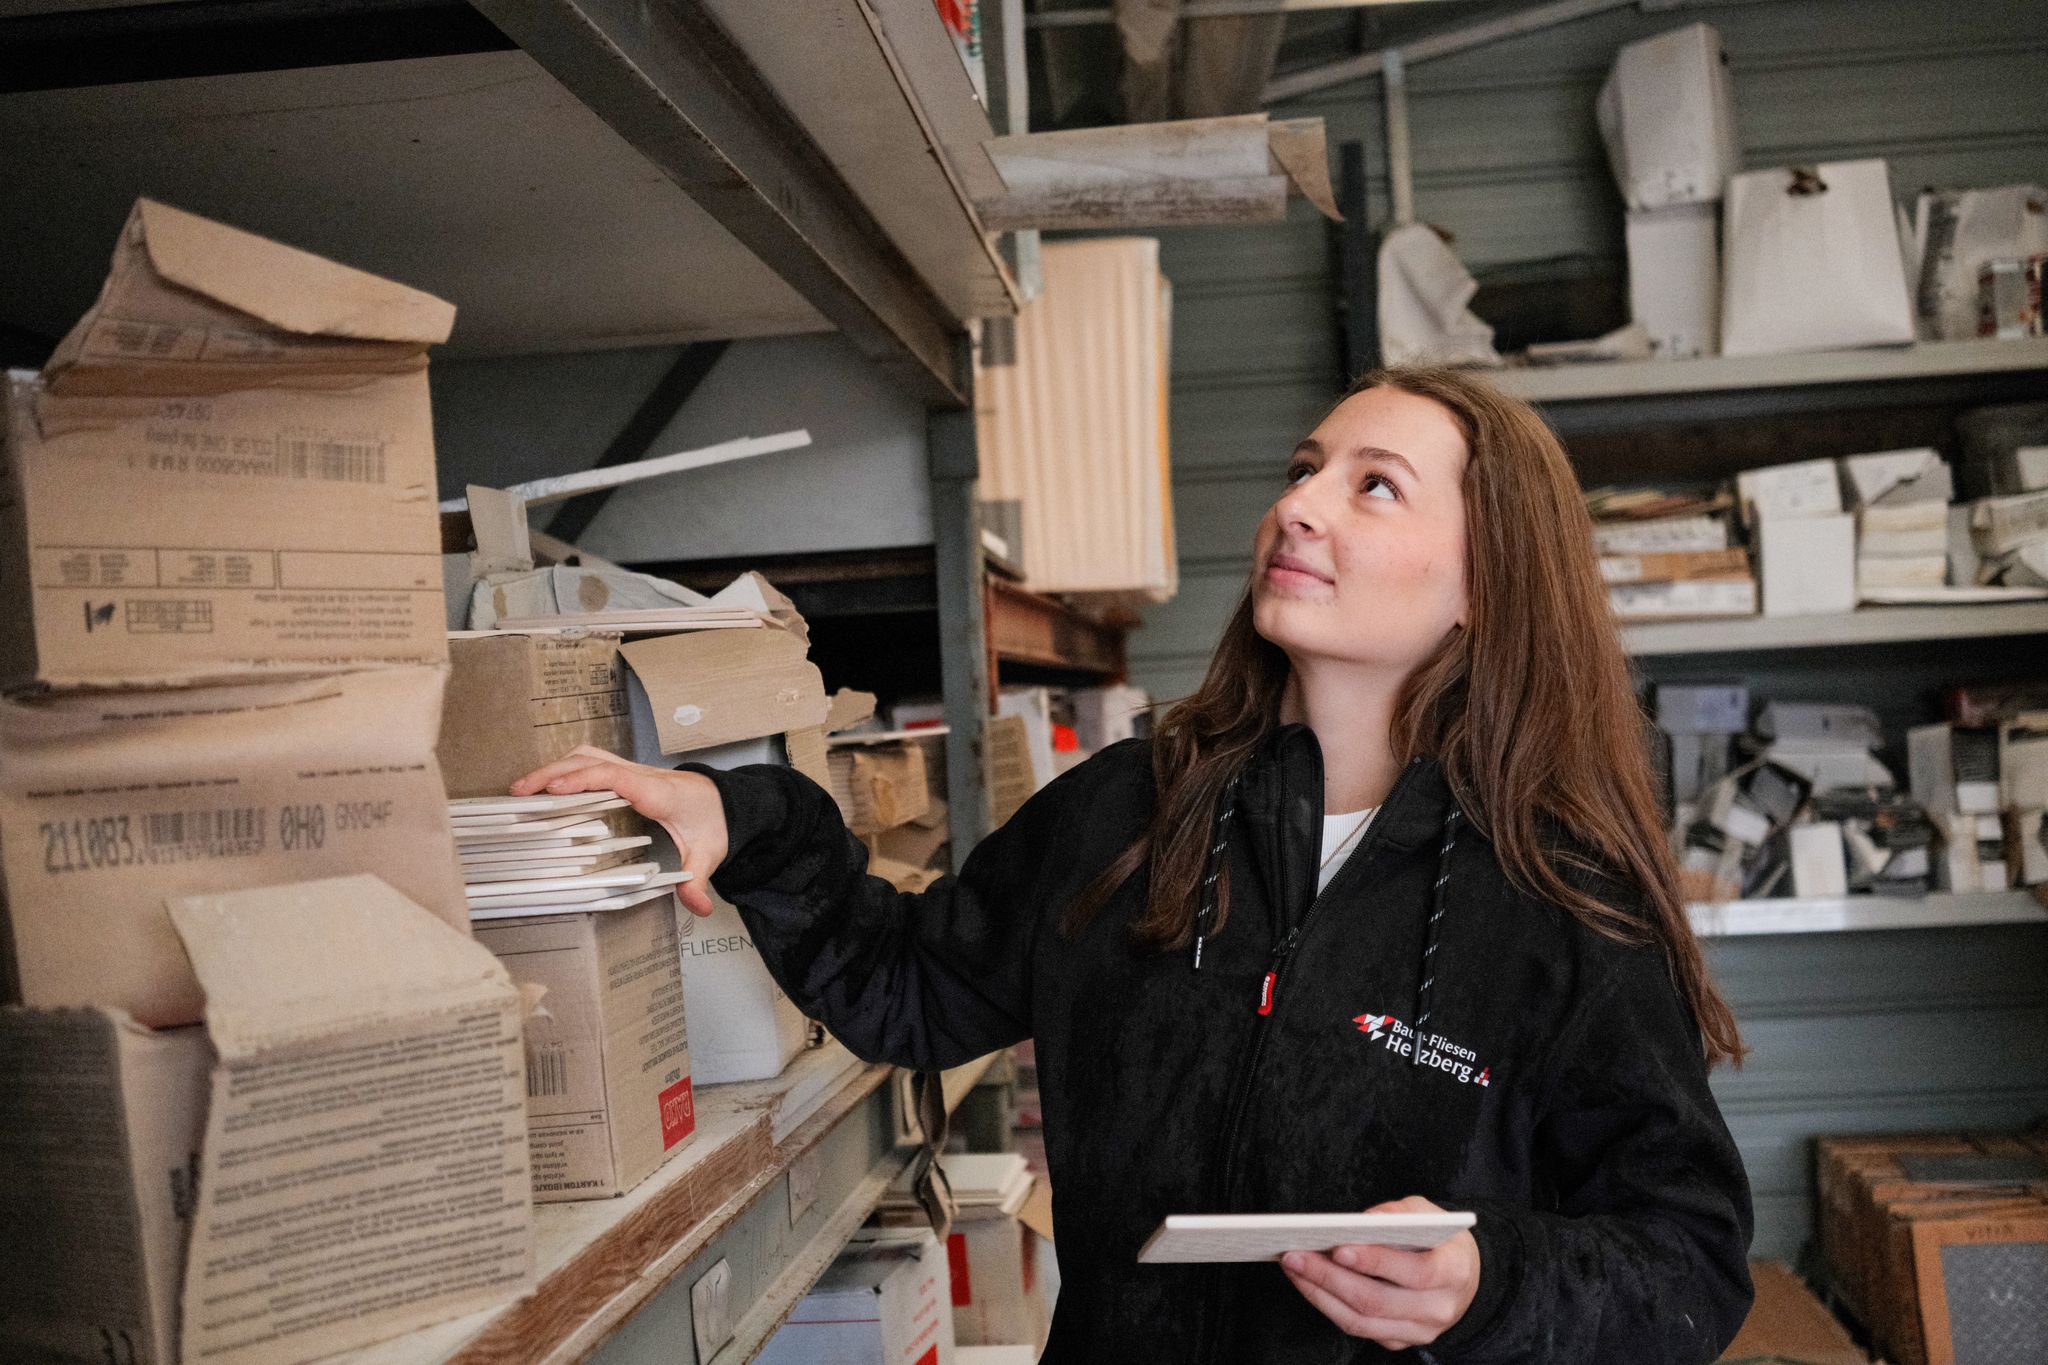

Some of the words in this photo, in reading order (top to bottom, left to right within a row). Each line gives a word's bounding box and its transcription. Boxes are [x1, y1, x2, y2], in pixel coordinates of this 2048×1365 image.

[680, 935, 754, 958] FLIESEN
[1385, 1033, 1474, 1084] Hezberg
[1429, 1034, 1476, 1063] Fliesen
[564, 1180, 598, 1190] KARTON
